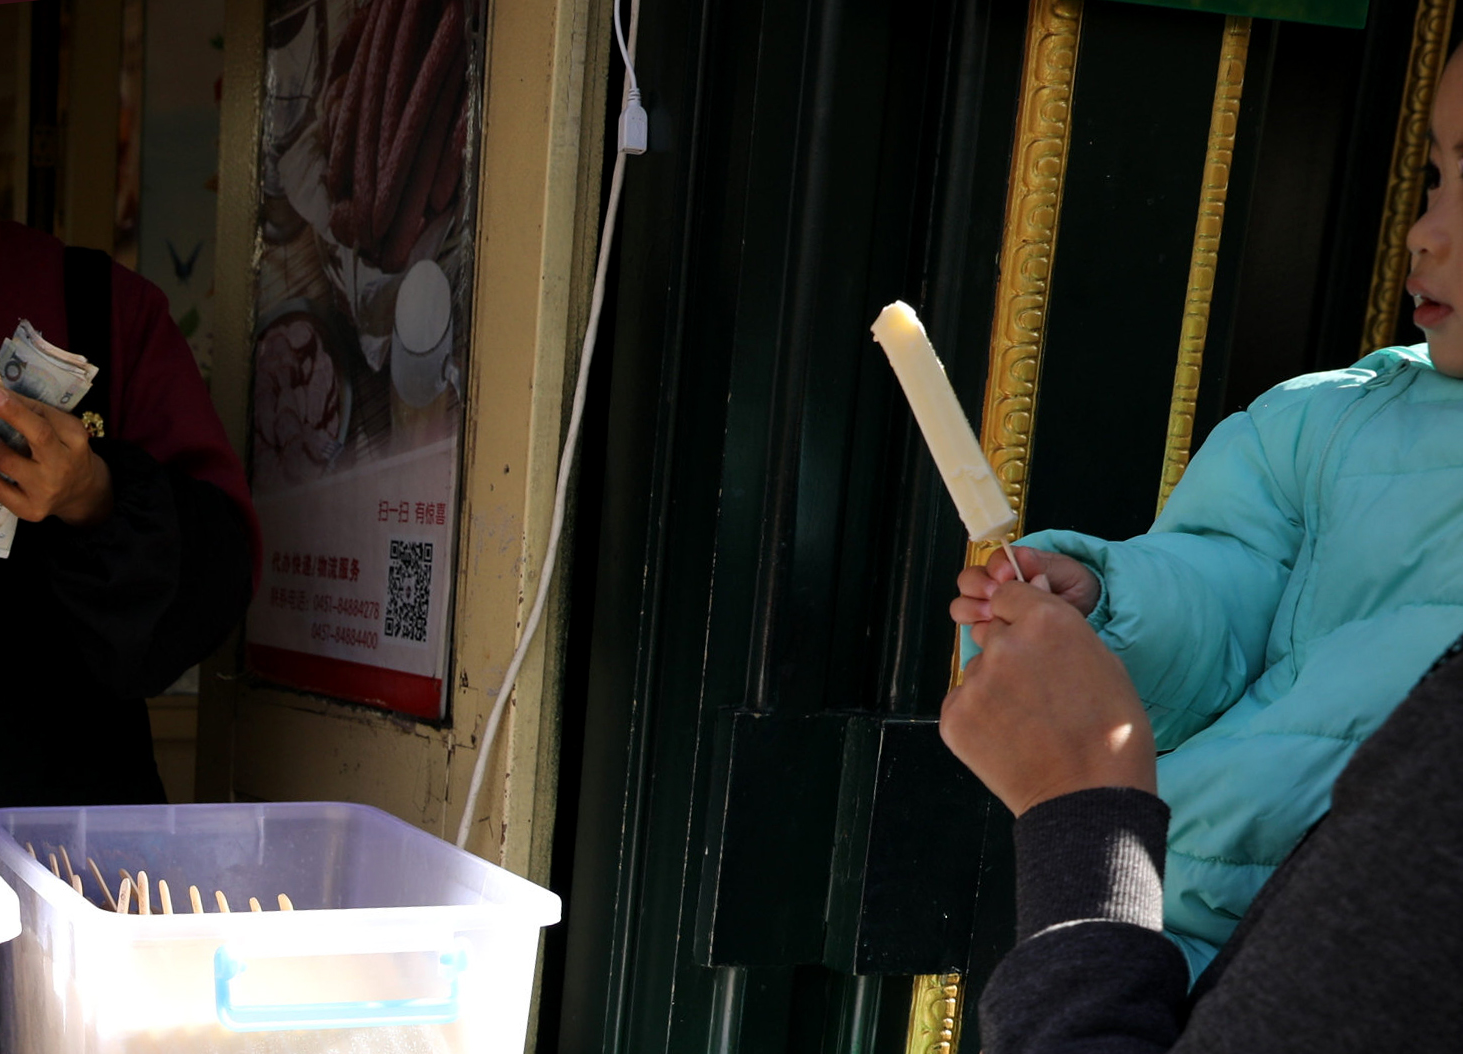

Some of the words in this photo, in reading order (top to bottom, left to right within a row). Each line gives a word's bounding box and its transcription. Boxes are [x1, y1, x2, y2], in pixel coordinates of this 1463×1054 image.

[378, 500, 409, 523] 扫一扫
[415, 502, 446, 525] 有惊喜
